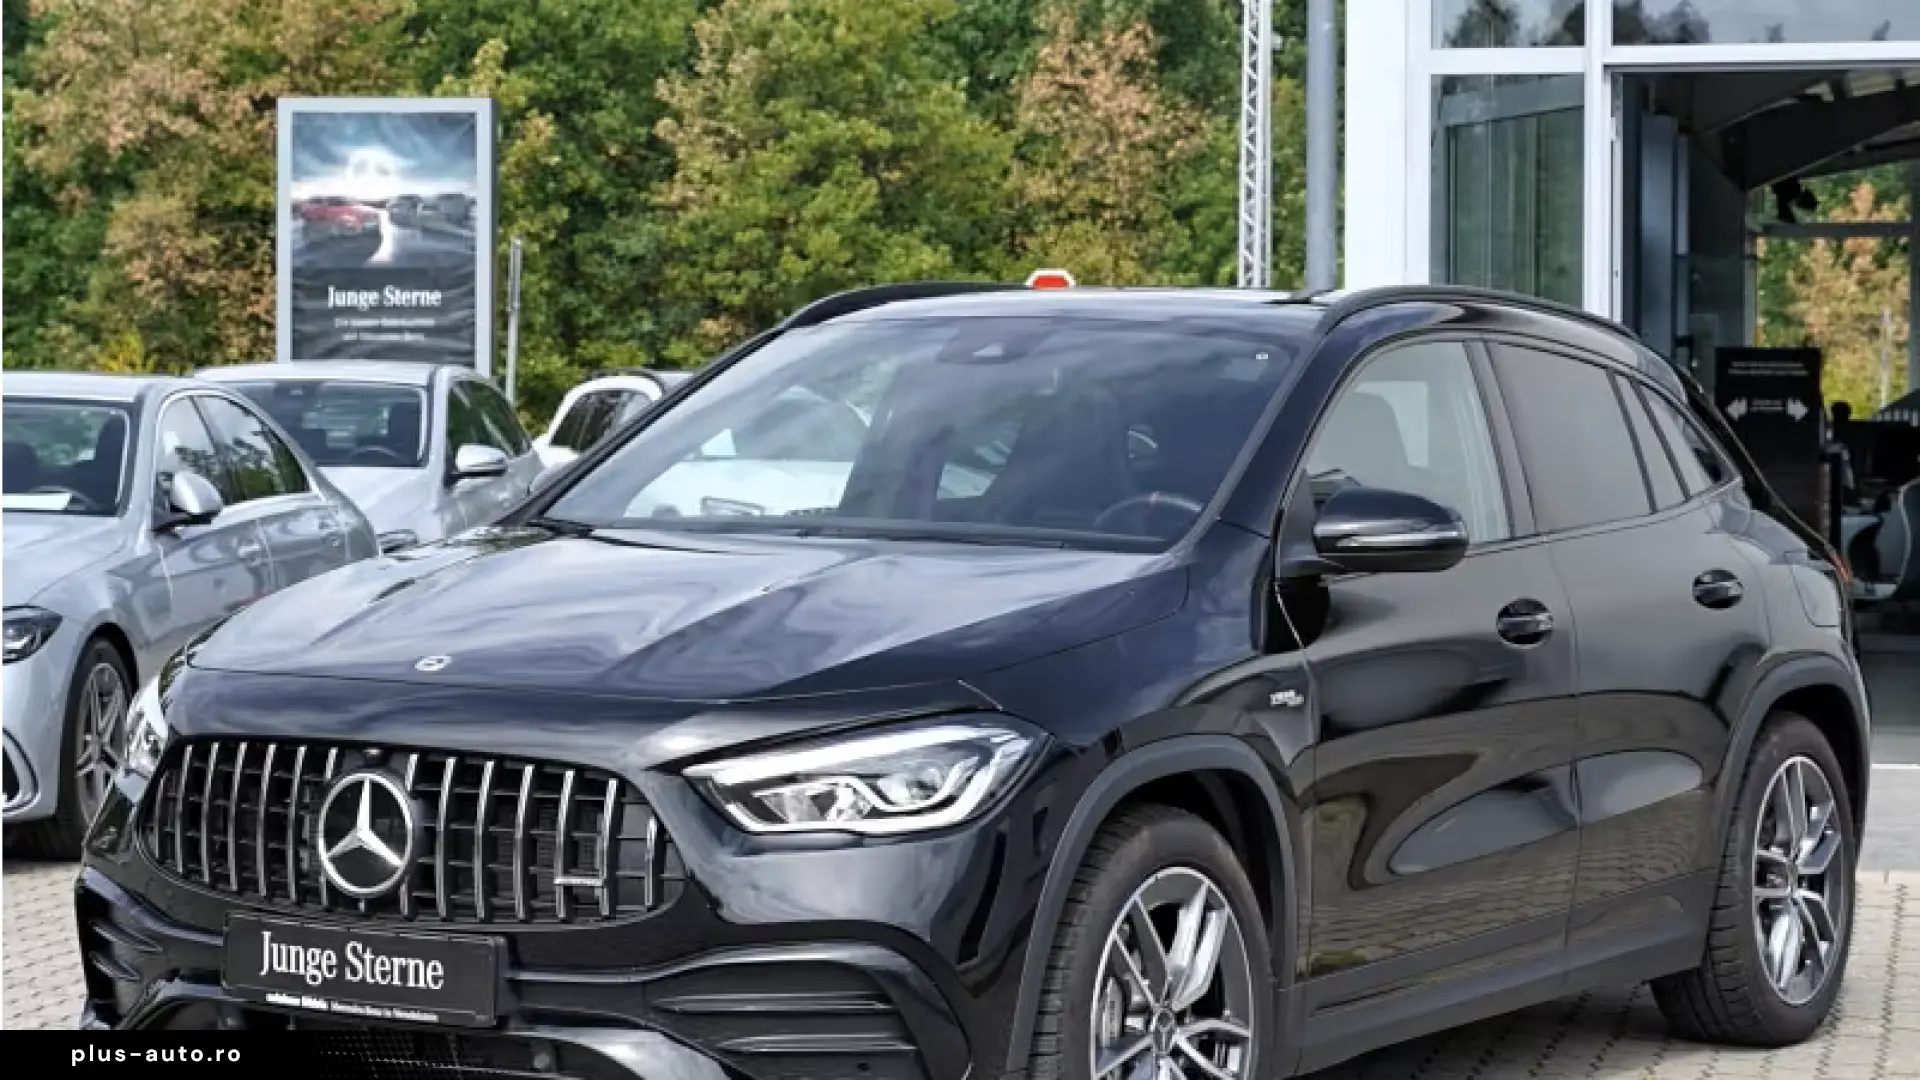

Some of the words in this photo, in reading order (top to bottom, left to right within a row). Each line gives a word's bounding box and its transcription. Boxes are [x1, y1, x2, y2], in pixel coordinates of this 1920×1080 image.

[328, 285, 380, 311] Junge
[382, 285, 442, 307] Sterne
[260, 930, 337, 985] Junge
[344, 940, 444, 990] Sterne
